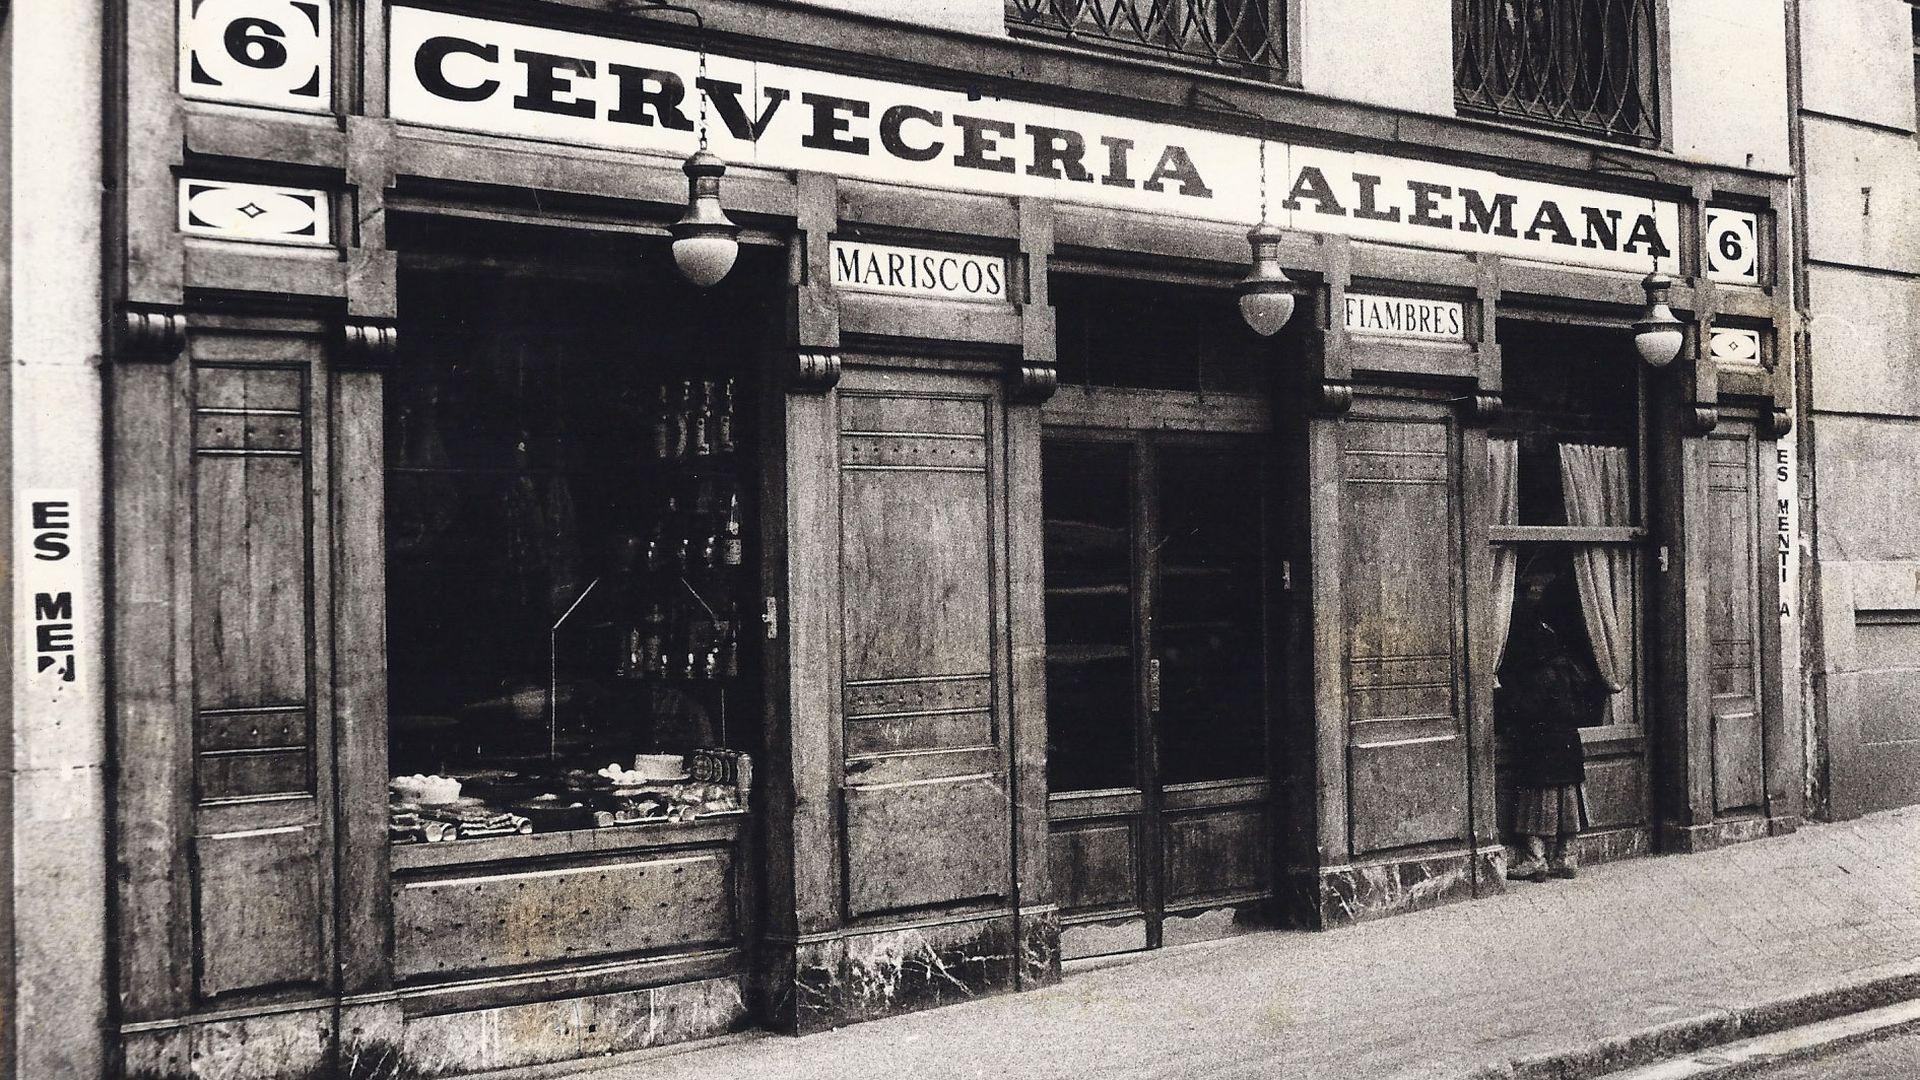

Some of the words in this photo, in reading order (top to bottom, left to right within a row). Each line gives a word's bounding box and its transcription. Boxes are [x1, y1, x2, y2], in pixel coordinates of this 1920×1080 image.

[224, 18, 287, 70] 6
[414, 36, 1213, 197] CERVECERIA
[1282, 166, 1671, 258] ALEMANA
[1719, 230, 1742, 260] 6
[836, 247, 1001, 295] MARISCOS
[1345, 297, 1459, 335] FIAMBRES
[1776, 449, 1788, 482] ES
[32, 501, 70, 561] ES
[1778, 499, 1791, 617] MENTIA
